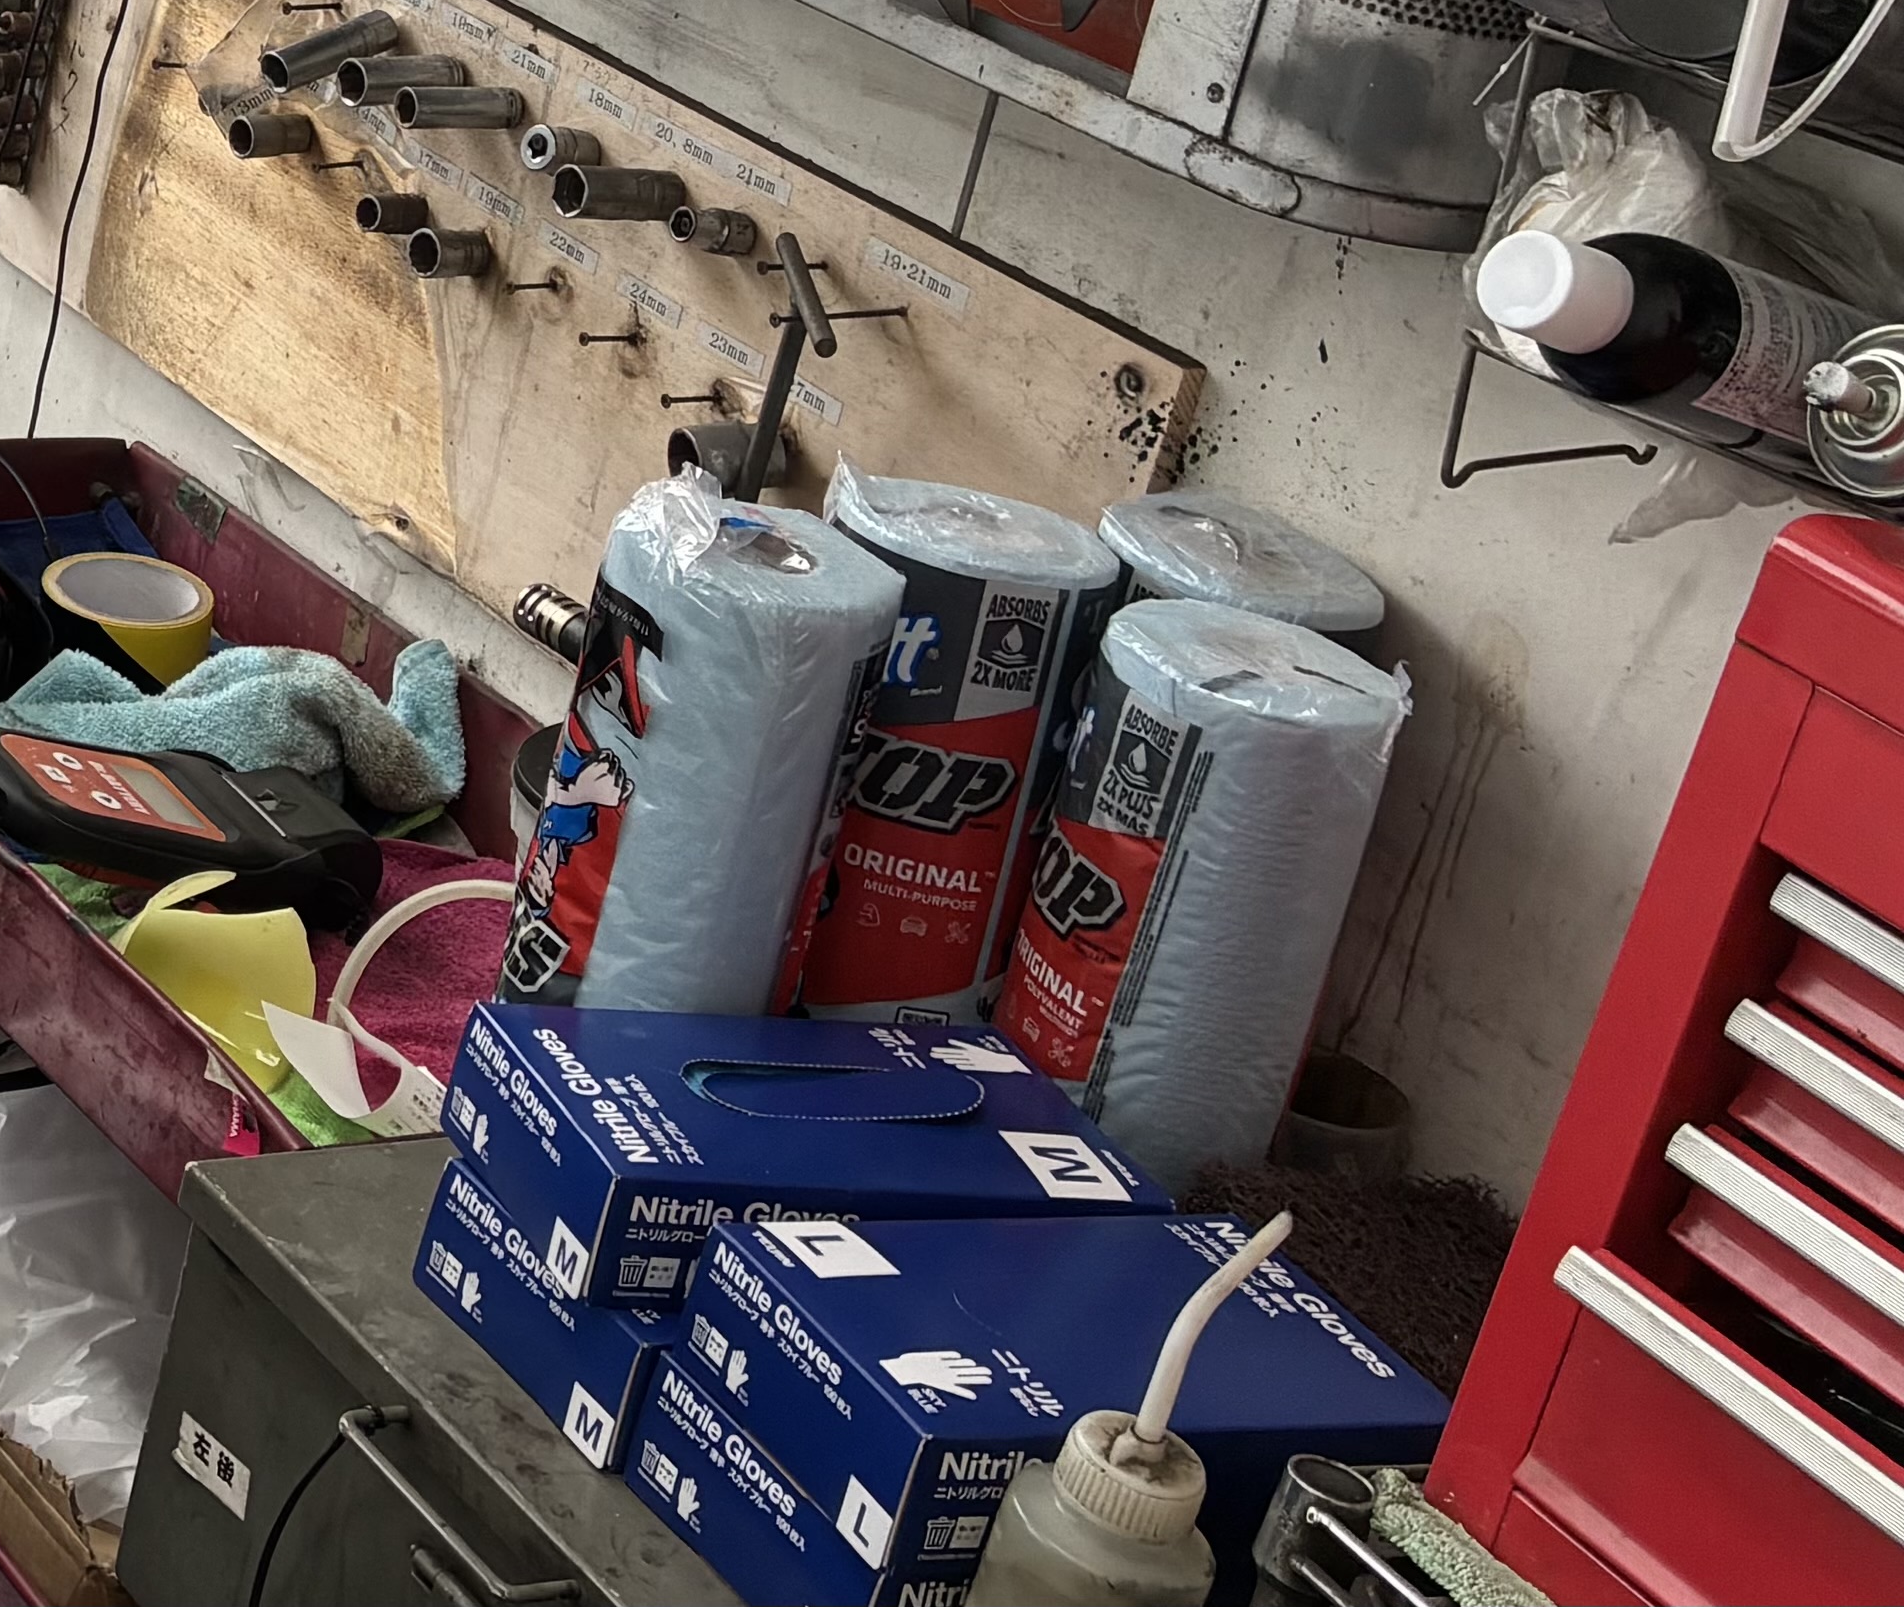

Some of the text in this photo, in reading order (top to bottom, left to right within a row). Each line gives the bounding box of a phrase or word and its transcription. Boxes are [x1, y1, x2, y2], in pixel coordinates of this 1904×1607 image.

[511, 50, 546, 79] 21mm
[588, 88, 623, 119] 18mm
[736, 163, 776, 196] 21mm
[418, 149, 450, 180] 17mm
[549, 231, 586, 264] 22mm
[629, 283, 668, 316] 24mm
[708, 333, 749, 366] 23mm
[790, 382, 826, 413] 7mm
[986, 593, 1051, 623] ABSORBS
[970, 660, 1037, 692] 2X MORE
[1124, 704, 1179, 757] ABSORBE
[1116, 786, 1162, 820] PLUS
[843, 843, 982, 893] ORIGINAL
[862, 879, 978, 912] MULTI-PURPOSE
[470, 1017, 558, 1137] Nitrile Gloves
[532, 1028, 660, 1163] Nitrile Gloves
[1028, 1145, 1103, 1184] M
[448, 1172, 503, 1238] Nitrile
[629, 1195, 734, 1226] Nitrile
[554, 1237, 579, 1285] M
[795, 1234, 845, 1257] L
[713, 1242, 773, 1314] Nitrile
[773, 1303, 843, 1386] Gloves
[1292, 1292, 1398, 1378] Gloves
[991, 1348, 1065, 1418] ニトリル
[574, 1402, 605, 1454] M
[661, 1369, 797, 1517] Nitrile Gloves
[938, 1450, 1044, 1481] Nitril
[853, 1501, 870, 1549] L
